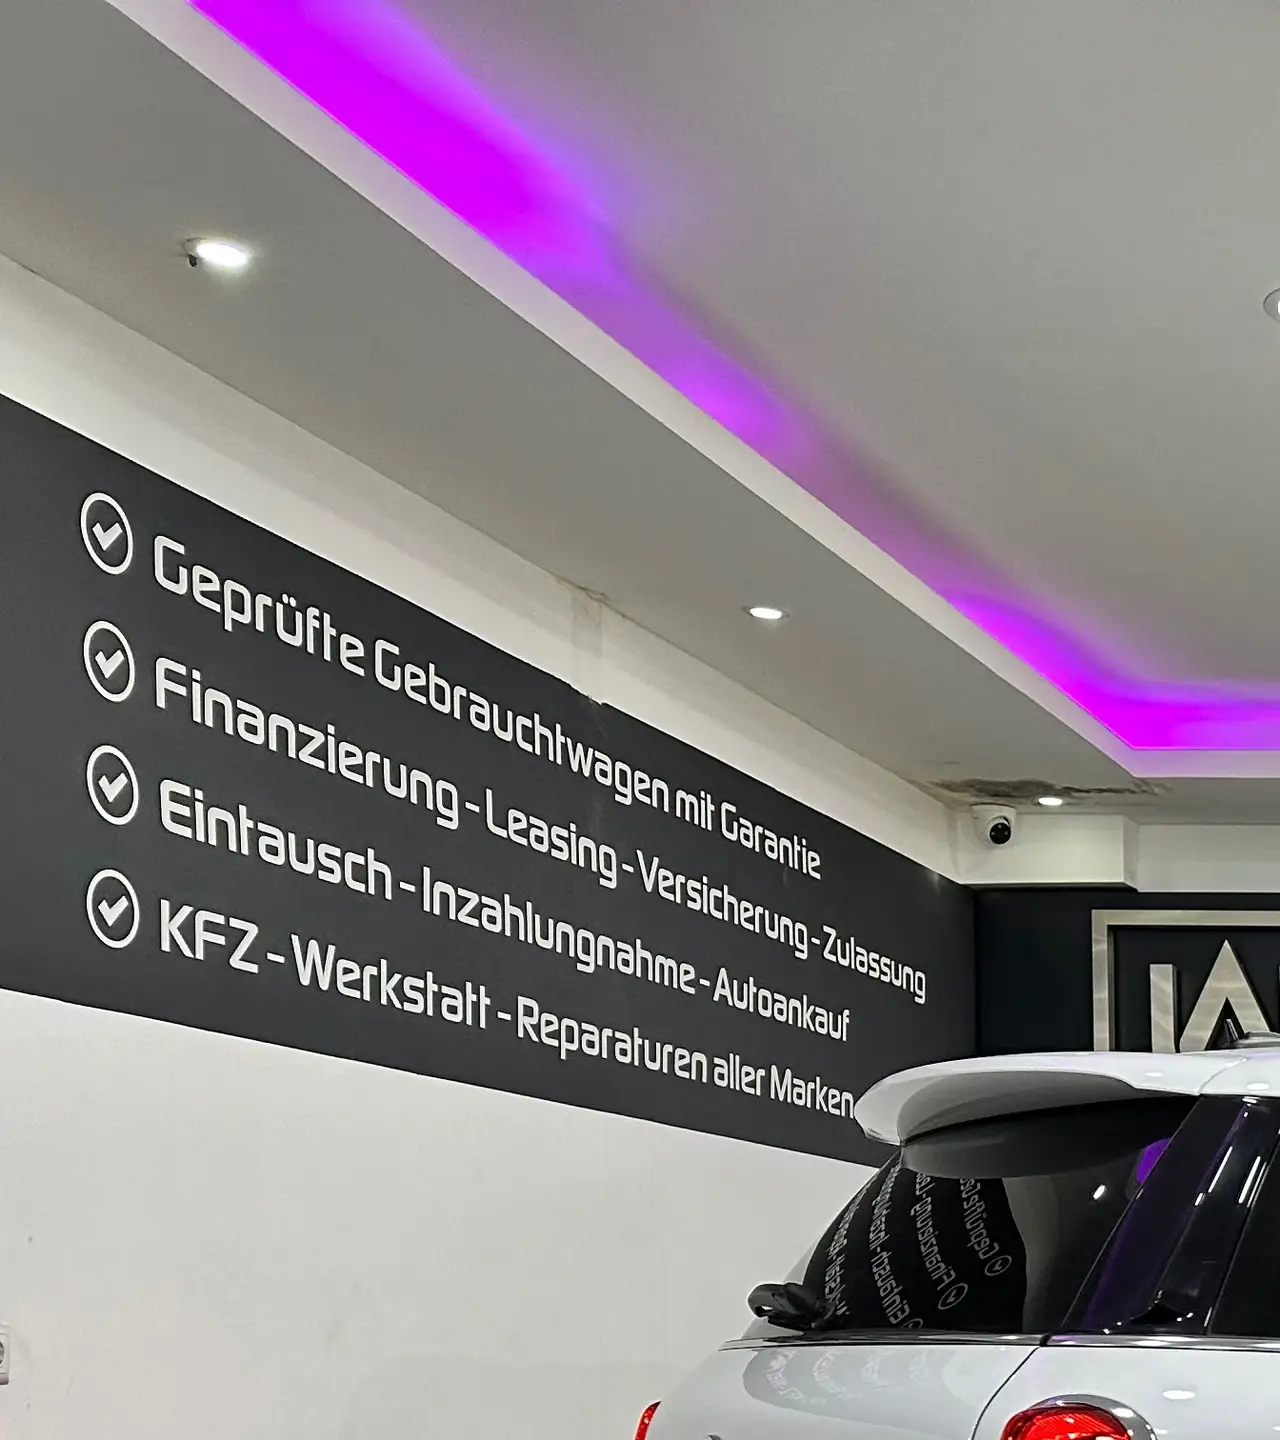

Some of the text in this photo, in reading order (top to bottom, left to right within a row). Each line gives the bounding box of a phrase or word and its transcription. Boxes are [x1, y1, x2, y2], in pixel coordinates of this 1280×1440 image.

[155, 536, 820, 879] Geprüfte Gebrauchtwagen mit Garantie
[714, 1053, 765, 1096] aller
[771, 1065, 853, 1118] Marken
